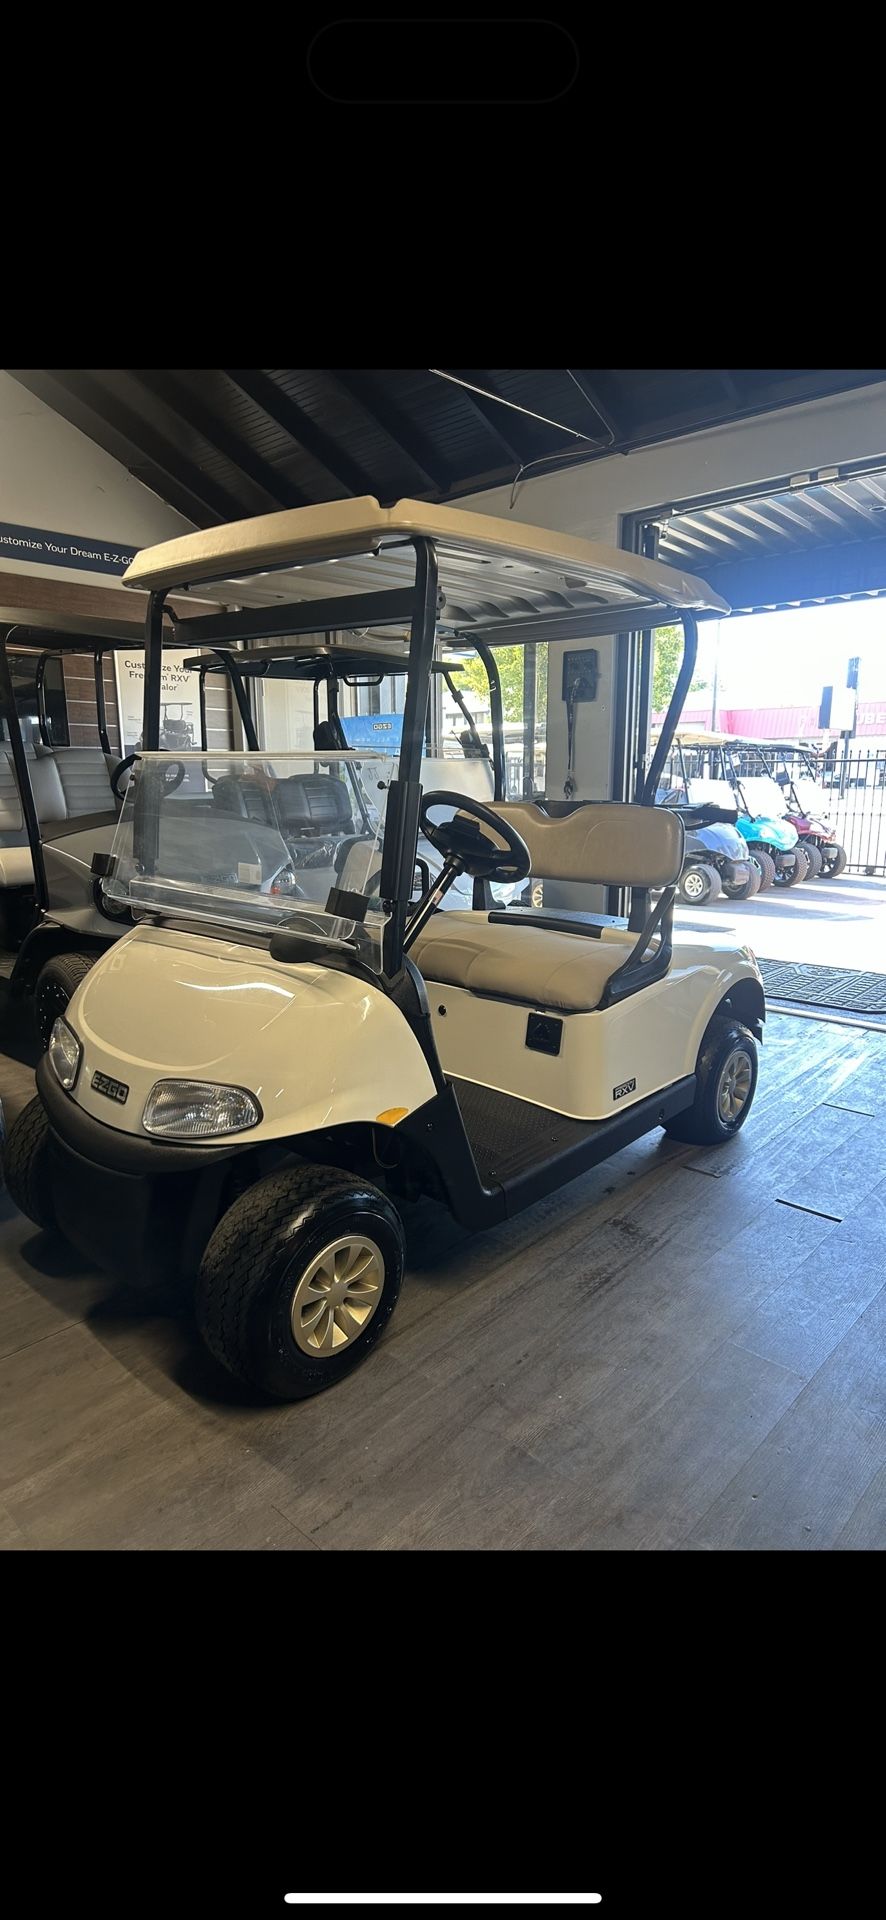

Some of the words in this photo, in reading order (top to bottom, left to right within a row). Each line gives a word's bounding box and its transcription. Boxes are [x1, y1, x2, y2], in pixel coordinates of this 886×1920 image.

[0, 536, 43, 550] ustomize
[45, 541, 68, 554] Your
[70, 546, 102, 560] Dream
[124, 660, 172, 672] Custze
[171, 675, 189, 683] RXV
[162, 683, 177, 691] alor
[615, 1080, 635, 1098] RXV
